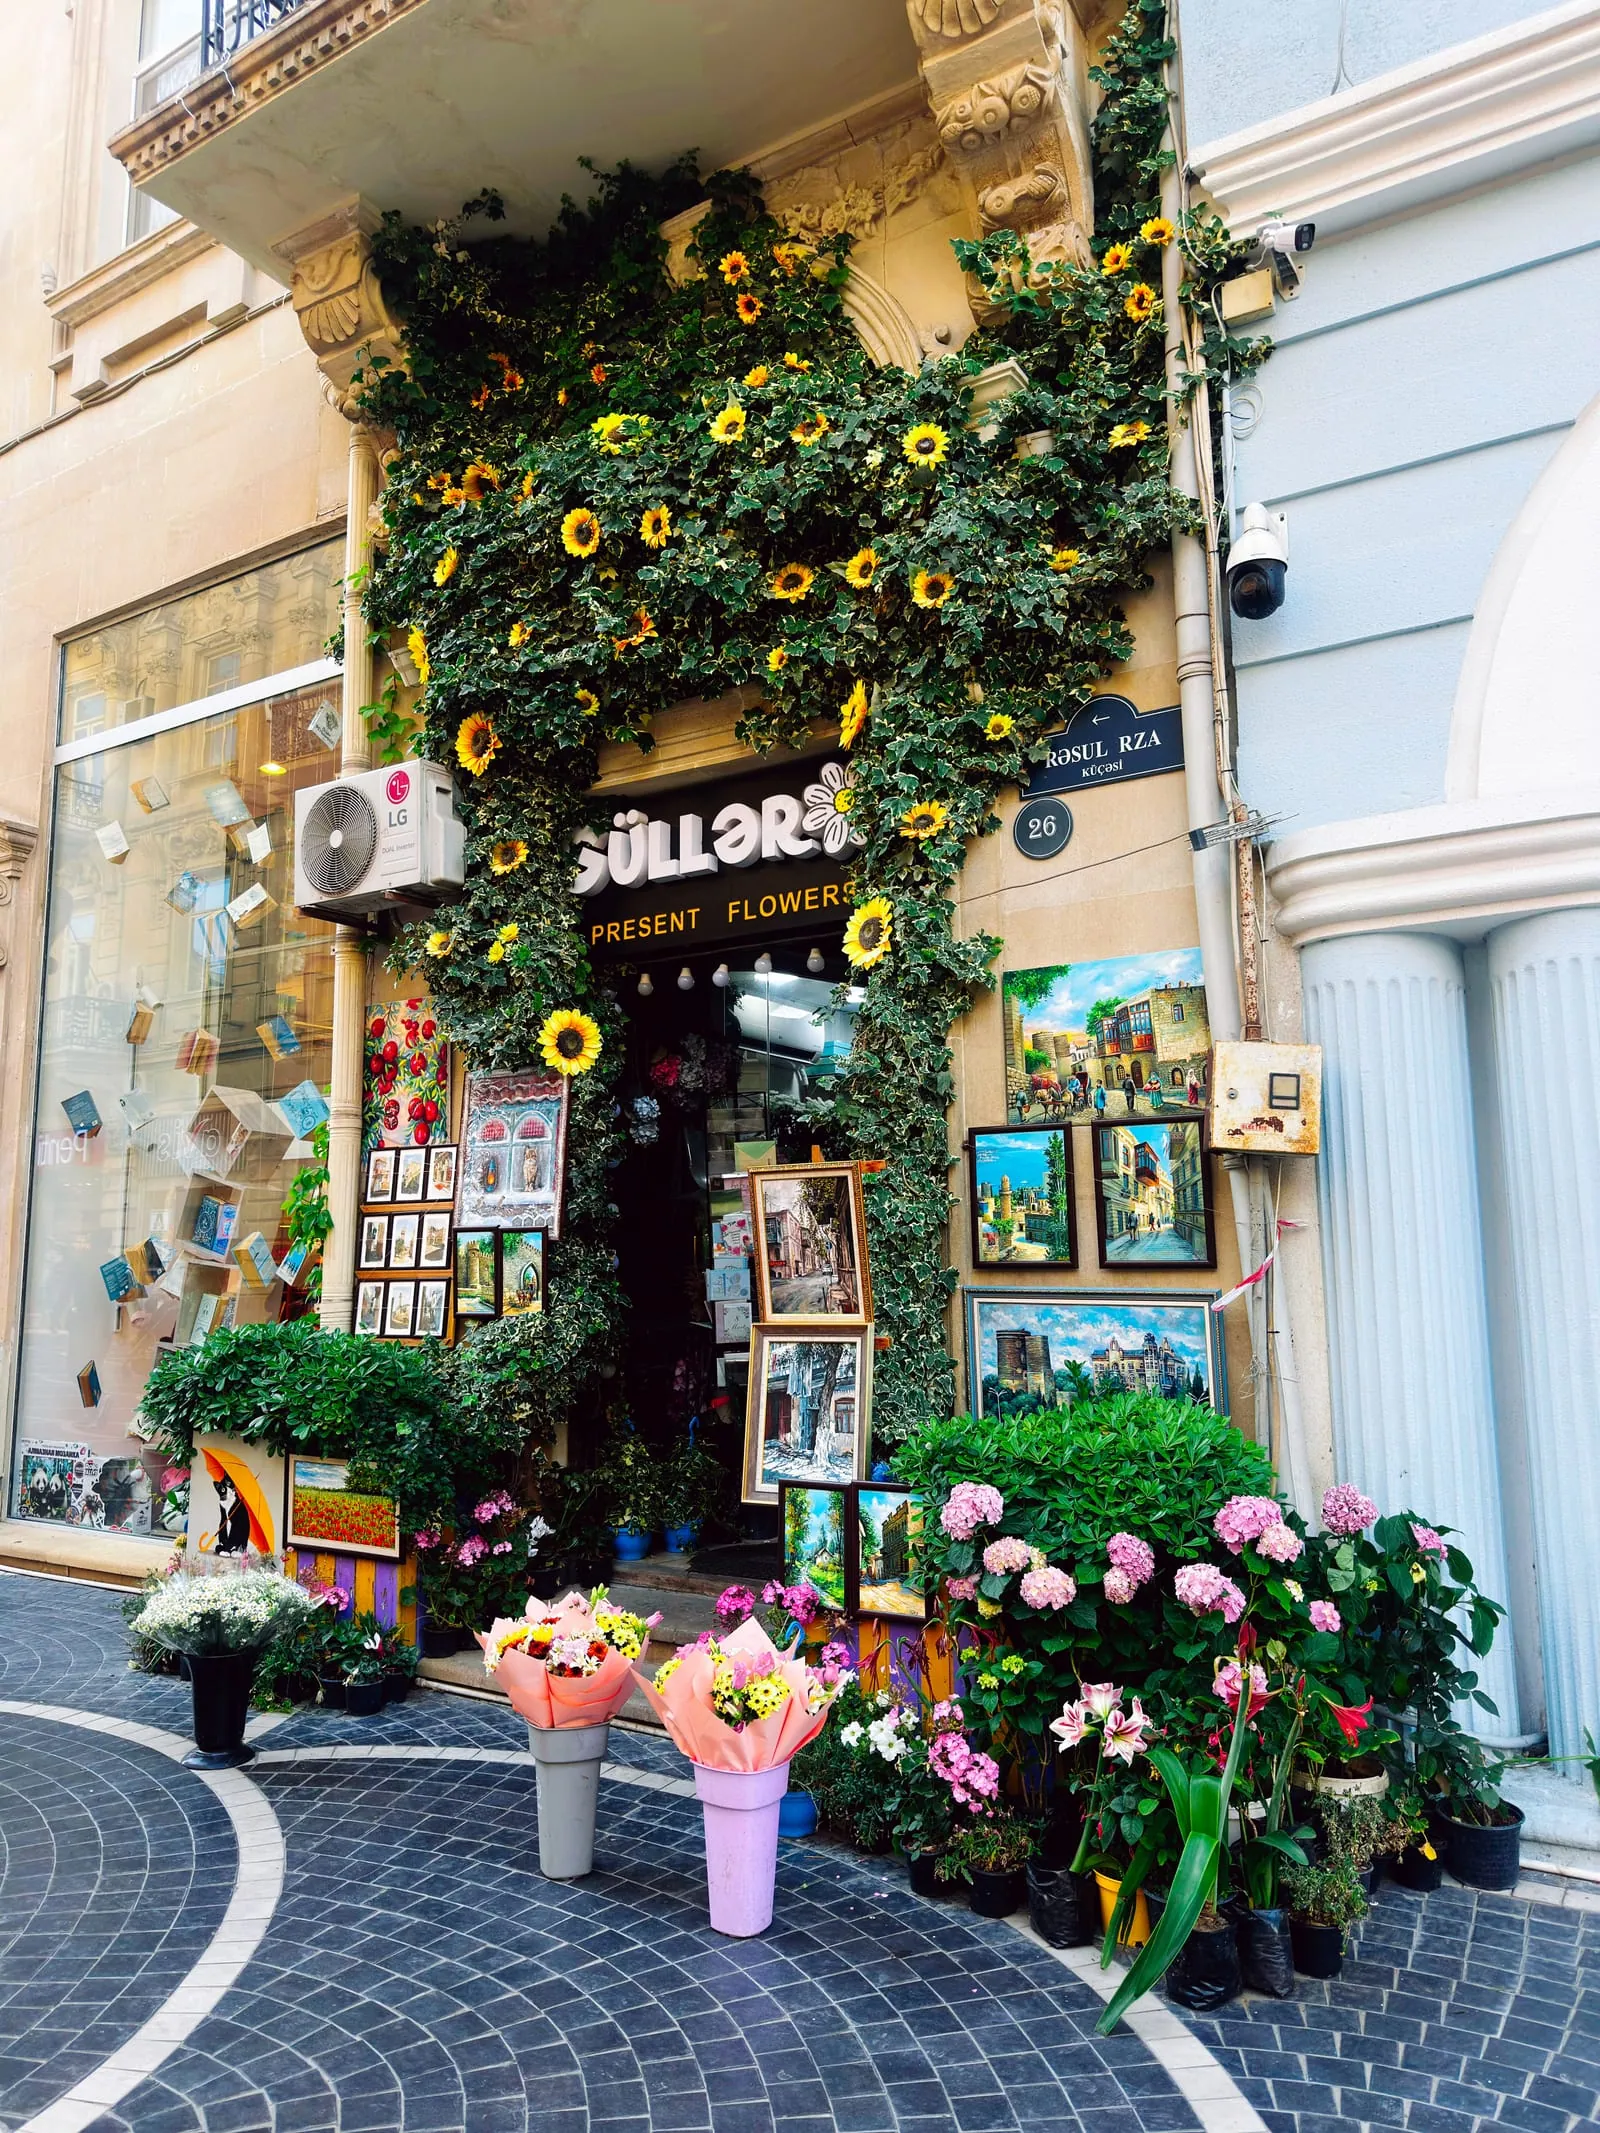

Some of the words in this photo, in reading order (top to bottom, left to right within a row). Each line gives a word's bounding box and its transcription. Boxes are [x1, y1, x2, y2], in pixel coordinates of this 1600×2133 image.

[1045, 740, 1108, 769] RƏSUL
[1118, 729, 1162, 753] RZA
[1081, 758, 1124, 778] KÜÇƏSİ
[388, 809, 408, 828] LG
[1028, 815, 1057, 840] 26
[591, 907, 701, 945] PRESENT
[728, 881, 855, 923] FLOWERS
